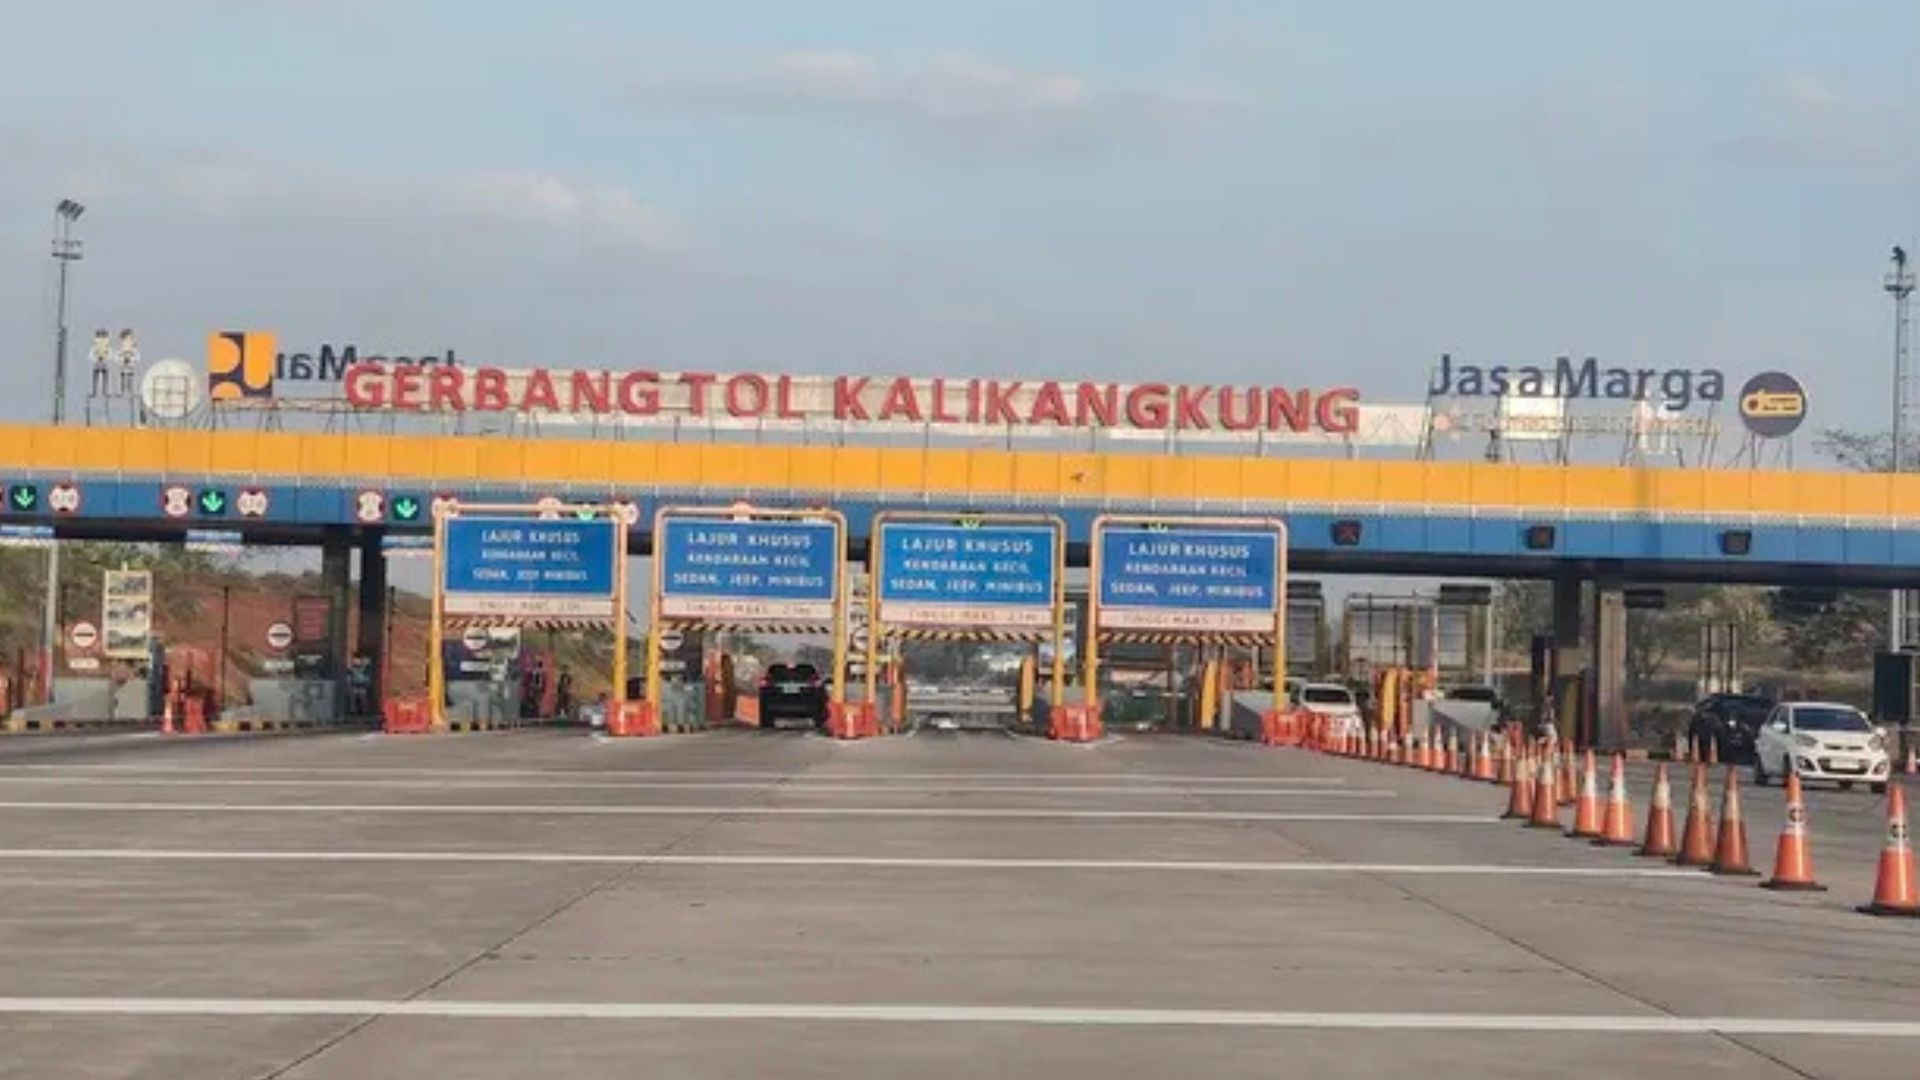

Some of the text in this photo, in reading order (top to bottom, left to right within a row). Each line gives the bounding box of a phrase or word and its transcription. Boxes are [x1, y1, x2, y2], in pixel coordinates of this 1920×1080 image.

[344, 361, 660, 416] GERBANG
[680, 371, 805, 419] TOL
[832, 375, 1361, 433] KALIKANGKUNG
[688, 531, 812, 548] LAJUR KHUSUS
[902, 537, 1033, 554] LAJUR KHUSUS
[1129, 542, 1249, 559] LAJUR KHUSUS
